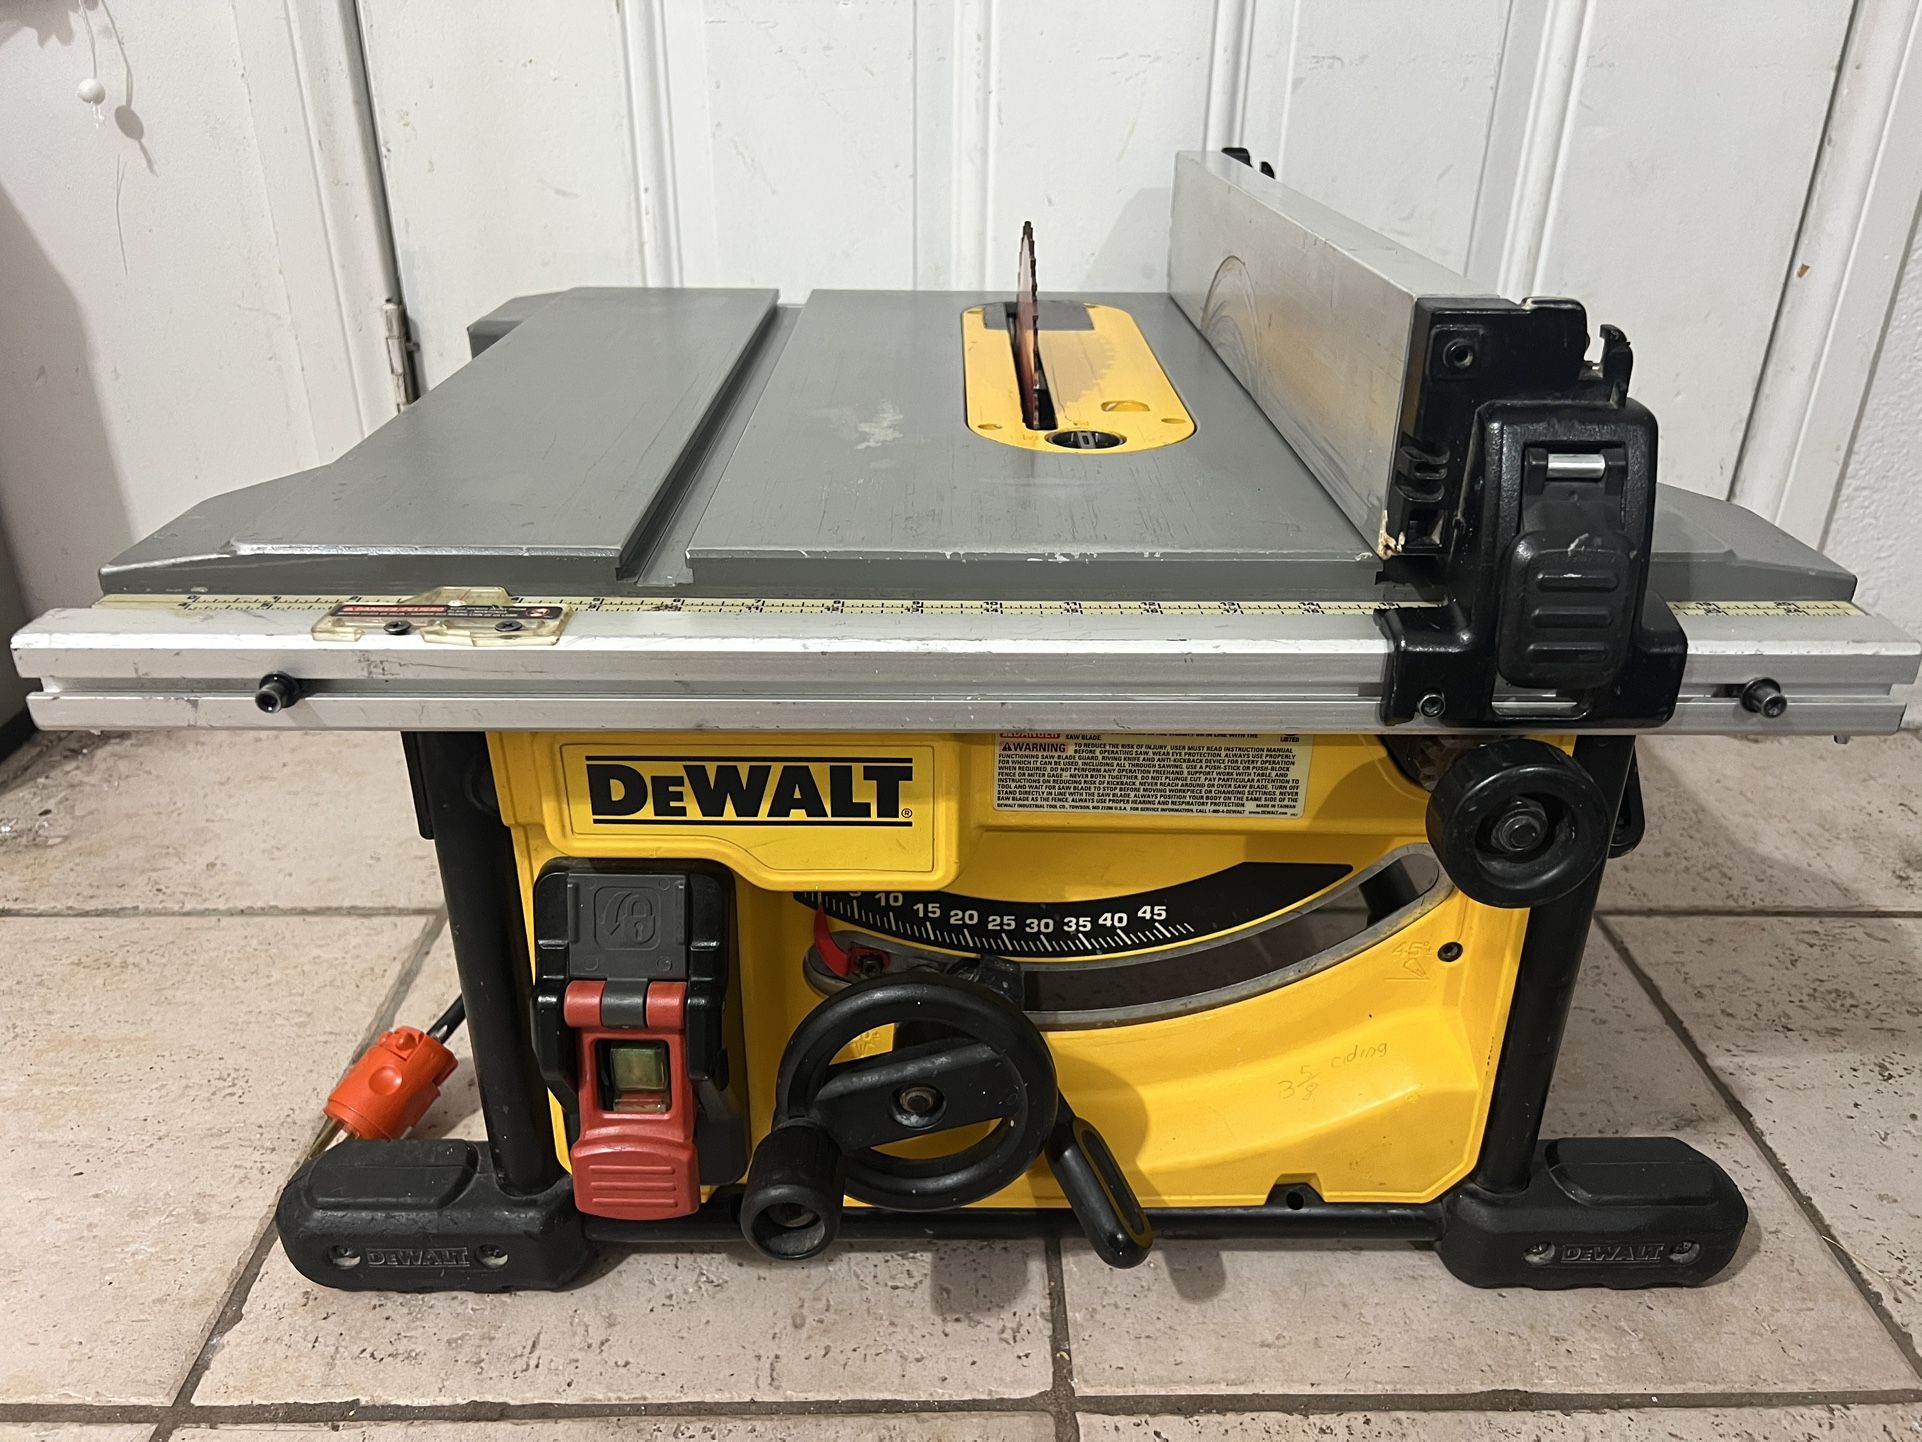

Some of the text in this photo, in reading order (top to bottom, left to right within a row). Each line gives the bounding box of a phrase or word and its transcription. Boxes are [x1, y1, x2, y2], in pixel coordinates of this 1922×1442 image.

[1013, 743, 1066, 753] WARNING
[586, 763, 913, 819] DEWALT
[875, 893, 1167, 933] 10 15 20 25 30 35 40 45
[367, 1248, 470, 1266] DEWALT
[1561, 1245, 1664, 1262] DEWALT
